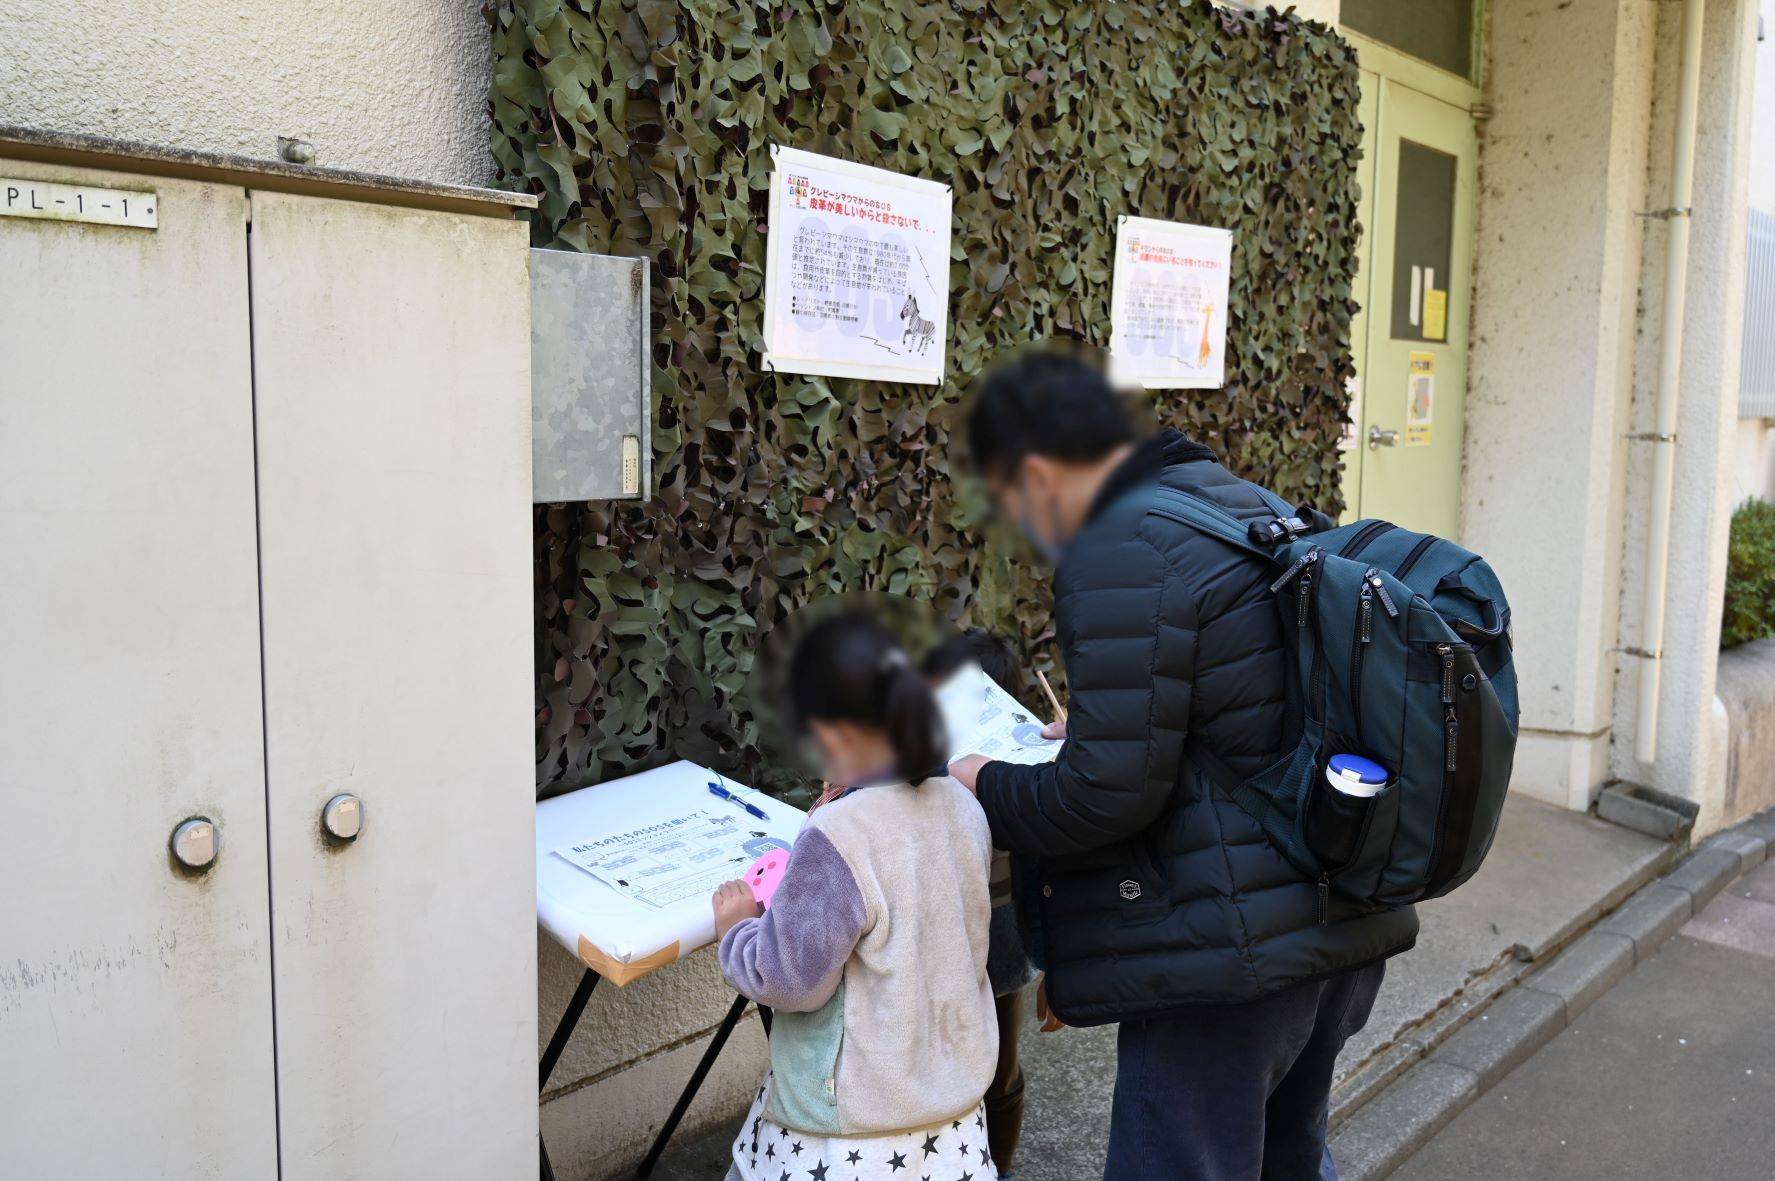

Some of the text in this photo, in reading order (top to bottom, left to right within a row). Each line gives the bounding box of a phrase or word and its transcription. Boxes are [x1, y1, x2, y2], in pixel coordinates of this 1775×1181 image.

[7, 187, 128, 218] PL-1-1
[810, 186, 891, 211] グレビーシマウマからのSOS
